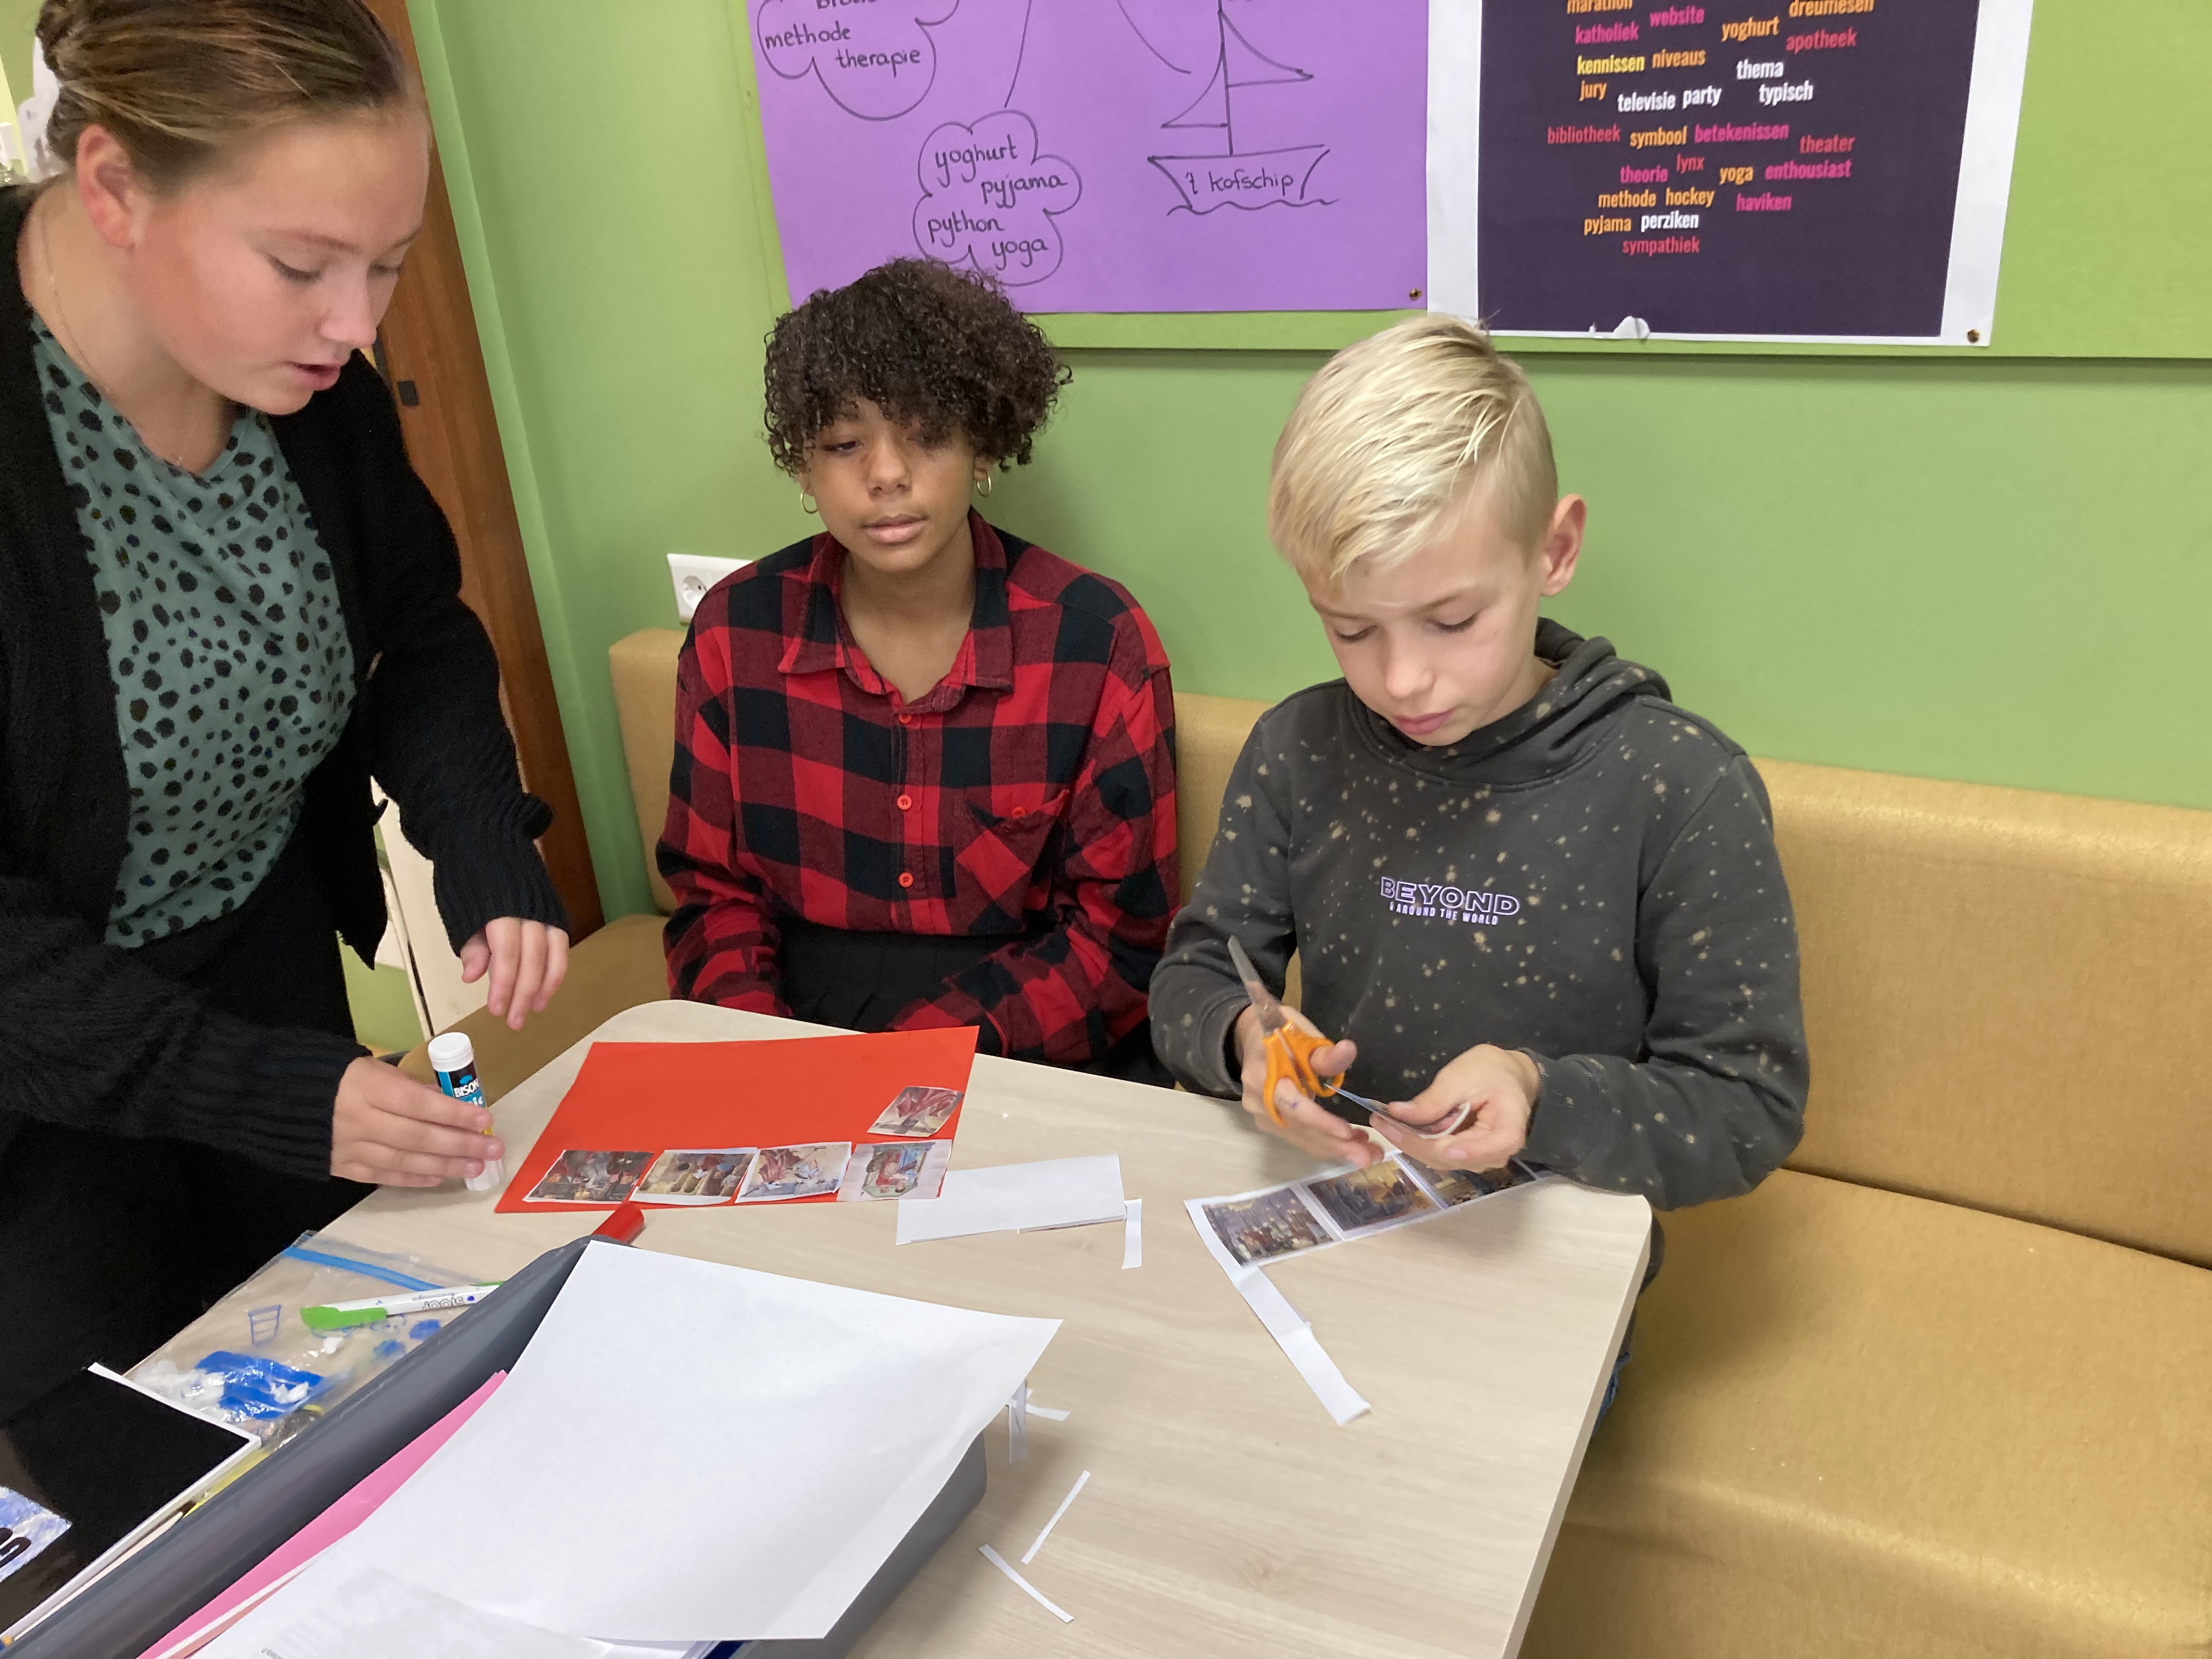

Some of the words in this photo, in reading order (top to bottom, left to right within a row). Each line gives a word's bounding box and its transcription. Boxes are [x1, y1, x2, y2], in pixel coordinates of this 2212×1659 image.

[1650, 6, 1704, 26] website
[765, 20, 850, 49] methode
[1576, 22, 1639, 44] katholiek
[1722, 16, 1779, 41] yoghurt
[1786, 28, 1857, 54] apotheek
[834, 48, 921, 78] therapie
[1577, 55, 1645, 75] kennissen
[1652, 49, 1706, 68] niveaus
[1737, 59, 1784, 80] thema
[1579, 81, 1607, 101] jury
[1618, 91, 1675, 112] televisie
[1683, 86, 1722, 109] party
[1759, 80, 1813, 106] typisch
[1548, 125, 1621, 144] bibliotheek
[1630, 126, 1687, 149] symbool
[1695, 122, 1789, 143] betekenissen
[1800, 135, 1855, 154] theater
[935, 134, 1018, 188] yoghurt
[1677, 154, 1705, 173] lynx
[1765, 159, 1852, 179] enthousiast
[1209, 167, 1293, 196] kofschip
[1620, 166, 1668, 183] theorie
[1720, 167, 1753, 184] yoga
[981, 173, 1068, 208] pyjama
[1599, 189, 1656, 207] methode
[1666, 187, 1715, 207] hockey
[1736, 192, 1792, 211] haviken
[927, 209, 1005, 247] python
[1584, 215, 1631, 235] pyjama
[1641, 210, 1699, 232] perziken
[991, 239, 1048, 271] yoga
[1623, 236, 1700, 256] sympathiek
[1380, 877, 1520, 916] BEYOND
[1396, 903, 1436, 917] AROUND
[1440, 908, 1458, 921] THE
[1463, 912, 1499, 926] WORLD
[454, 1077, 479, 1098] BISON
